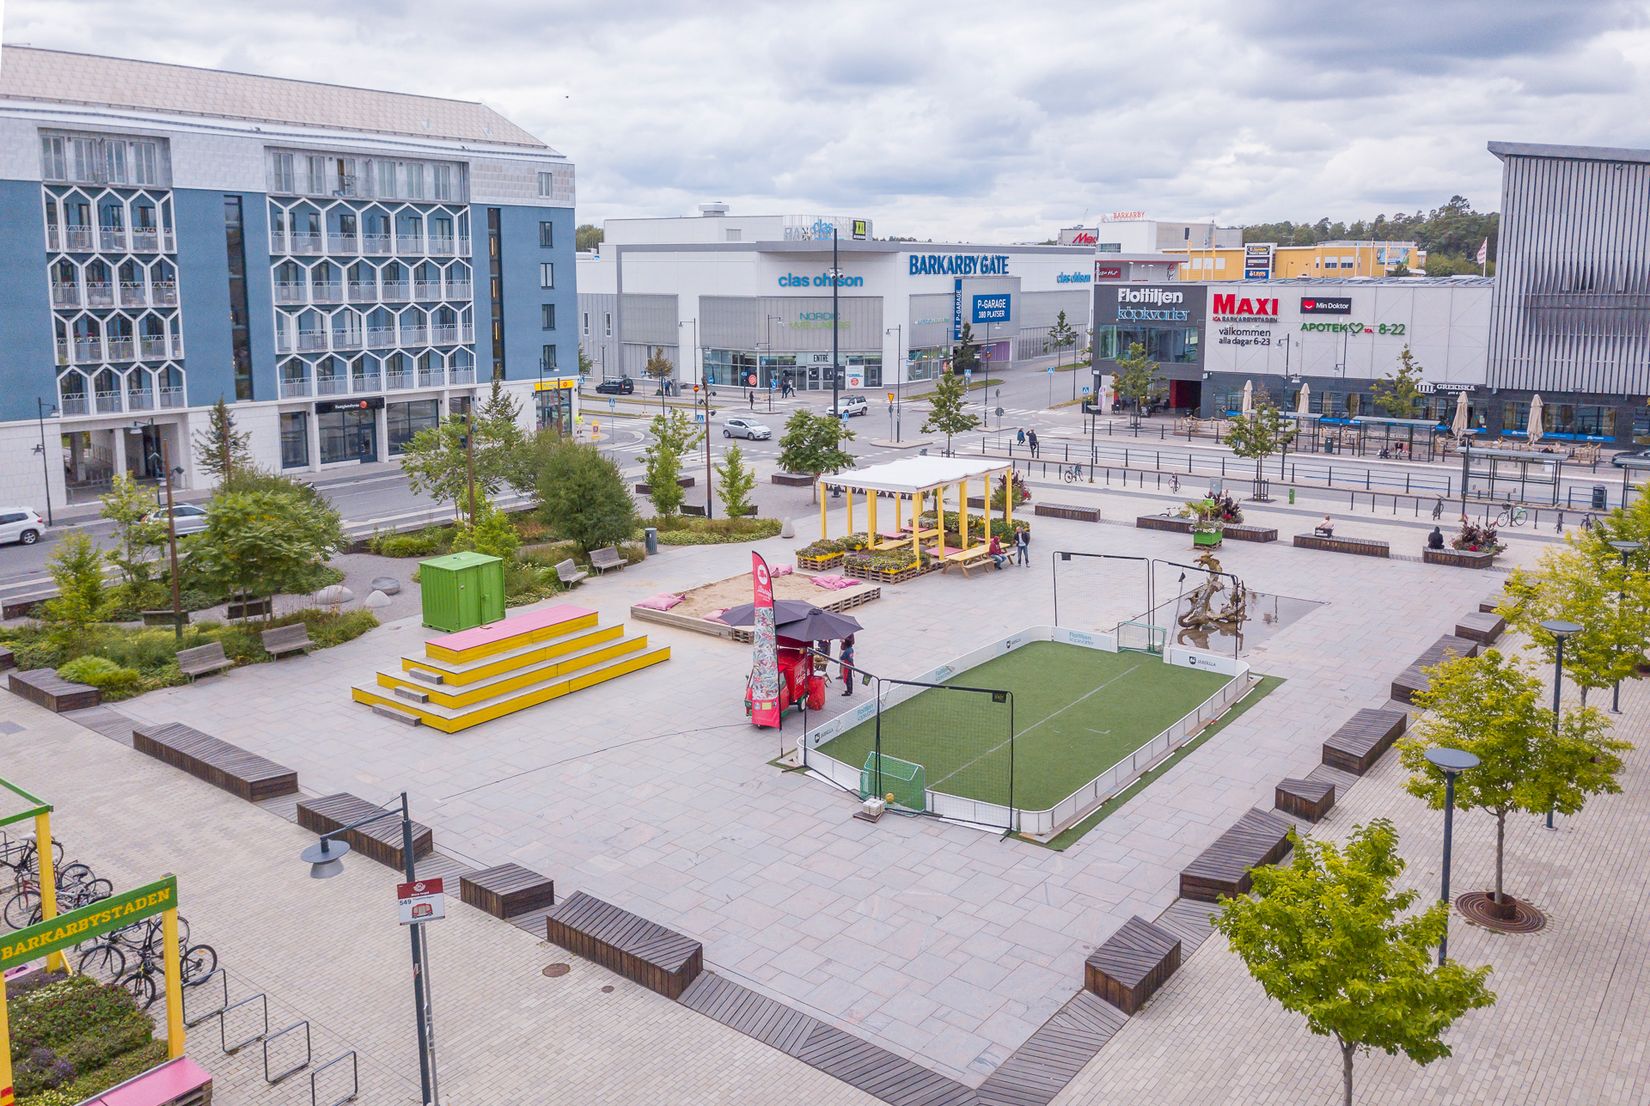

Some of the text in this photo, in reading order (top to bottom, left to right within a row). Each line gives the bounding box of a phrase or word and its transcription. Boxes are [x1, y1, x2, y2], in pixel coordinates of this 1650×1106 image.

[909, 255, 1009, 275] BARKARBY GATE
[778, 273, 864, 287] clas ohson
[1057, 272, 1091, 283] clas ohlson
[1117, 288, 1183, 306] Flottiljen
[977, 299, 1006, 309] P-GARAGE
[1213, 294, 1279, 315] MAXI
[1316, 301, 1350, 310] Min Doktor
[987, 310, 1005, 318] PLATSER
[1117, 305, 1190, 323] köpkvarter
[1219, 327, 1271, 338] välkommen
[1300, 323, 1348, 333] APOTEK
[1379, 324, 1406, 335] 8-22
[1219, 337, 1271, 347] alla dagar 6-23
[1436, 383, 1476, 391] GREKISKA
[1, 887, 171, 960] BARKARBYSTADEN
